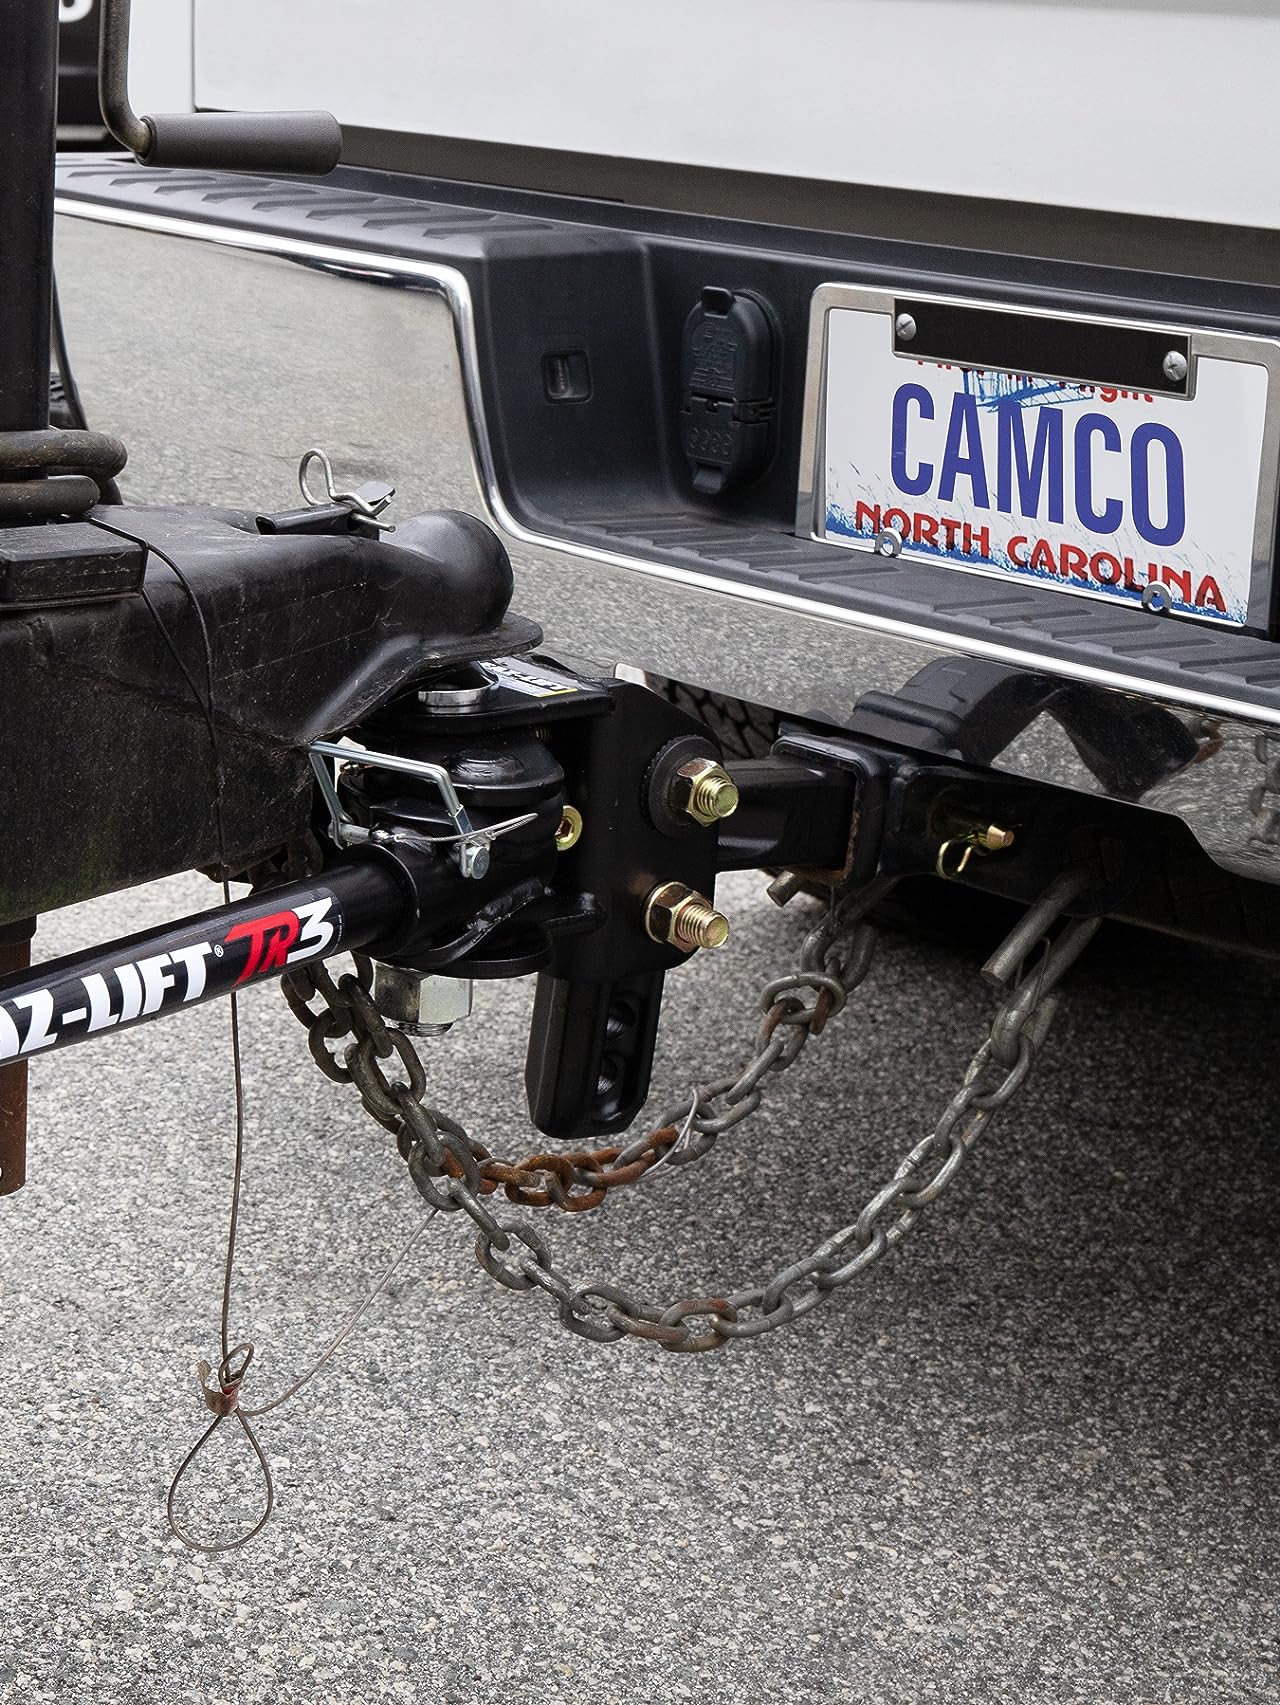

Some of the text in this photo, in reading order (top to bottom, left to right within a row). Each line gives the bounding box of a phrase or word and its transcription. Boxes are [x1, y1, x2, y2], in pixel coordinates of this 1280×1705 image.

[890, 382, 1186, 547] CAMCO
[854, 500, 1227, 612] NORTH CAROLINA
[224, 896, 333, 991] TR3
